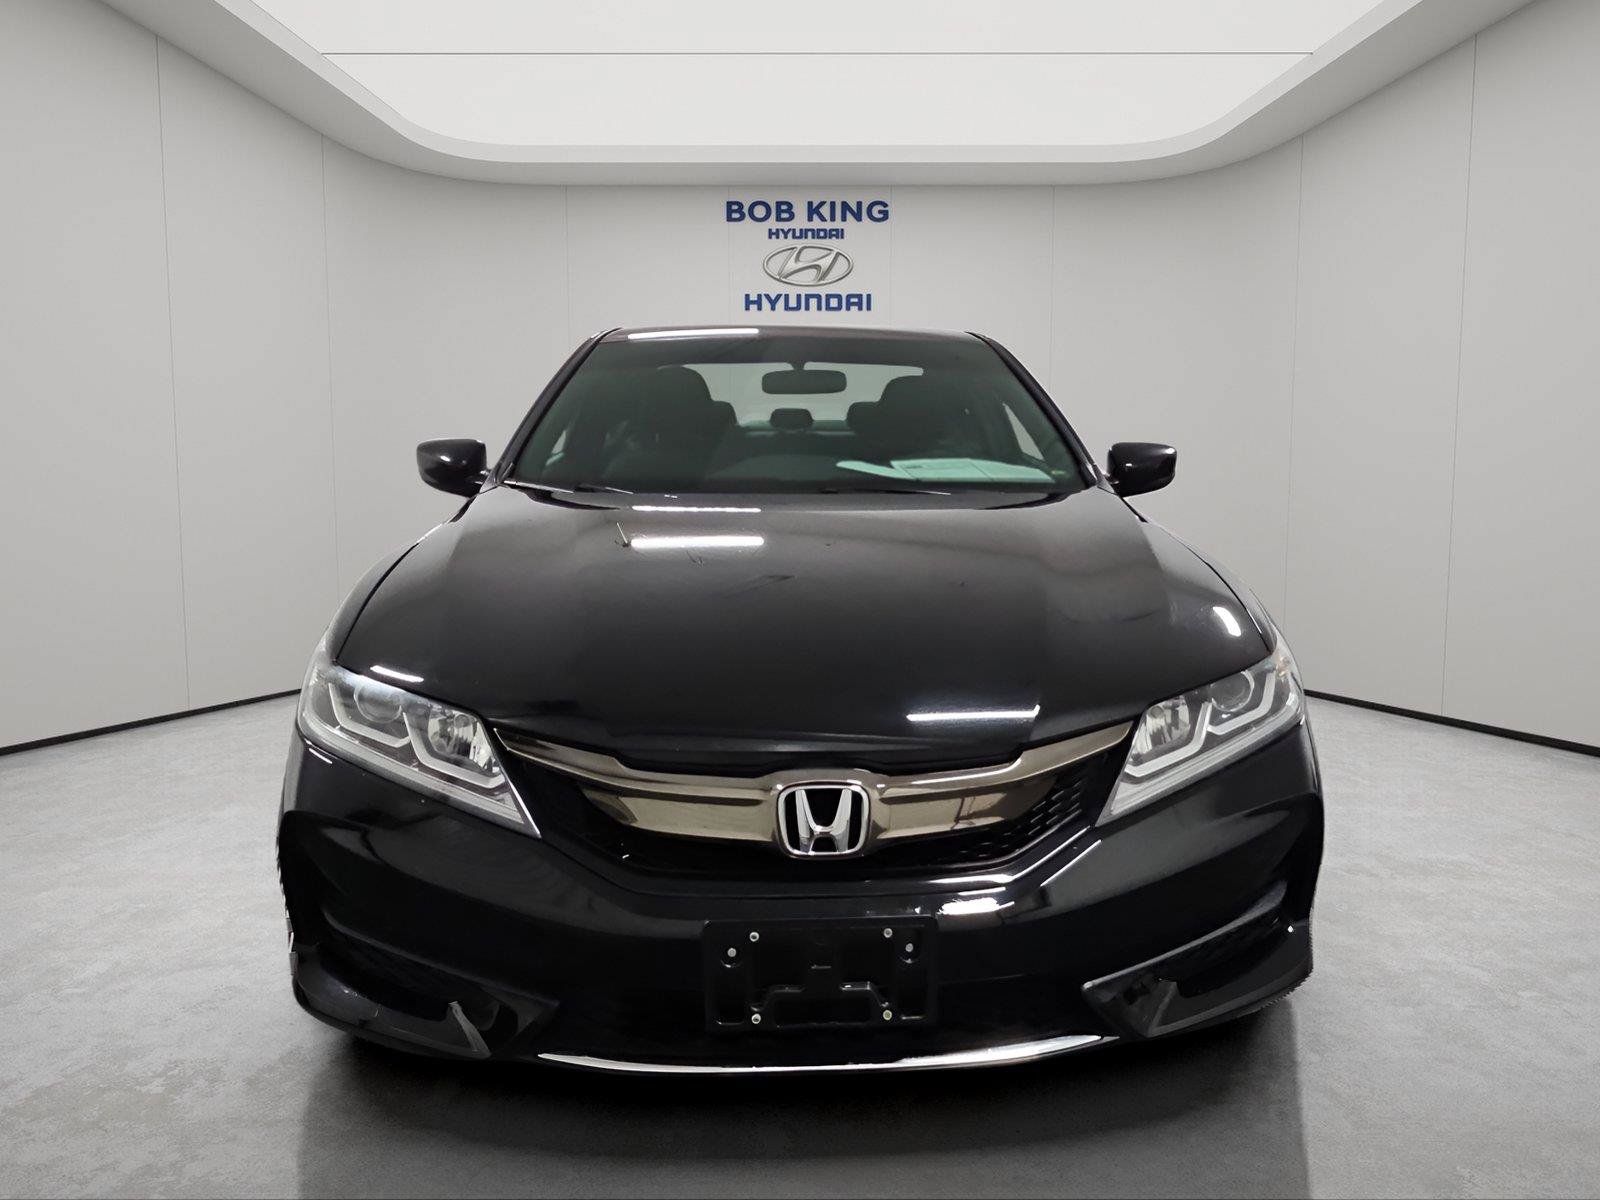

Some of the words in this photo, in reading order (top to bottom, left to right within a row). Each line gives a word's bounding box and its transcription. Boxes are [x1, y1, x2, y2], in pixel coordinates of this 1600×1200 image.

[725, 200, 795, 222] BOB
[806, 200, 889, 222] KING
[768, 228, 844, 239] HYUNDAI
[744, 293, 872, 311] HYUNDAI
